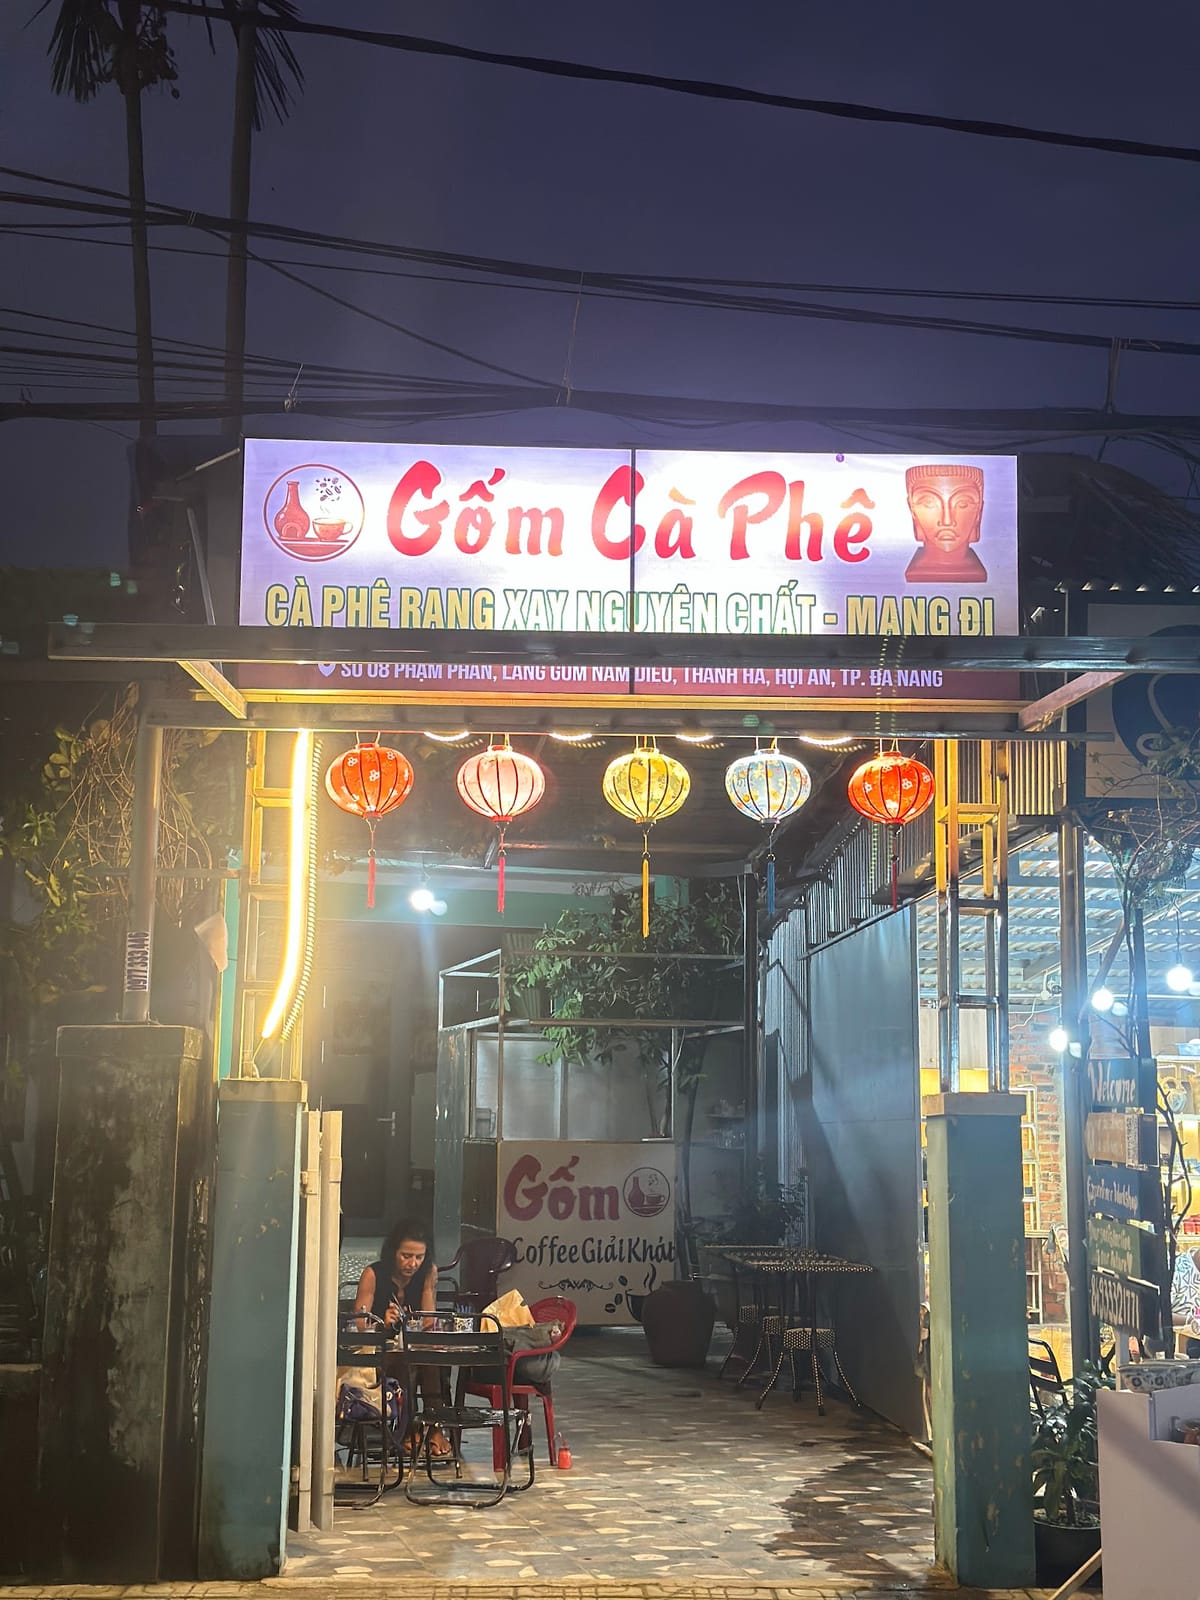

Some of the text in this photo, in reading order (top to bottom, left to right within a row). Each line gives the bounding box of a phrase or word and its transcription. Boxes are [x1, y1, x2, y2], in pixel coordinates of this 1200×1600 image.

[387, 460, 876, 562] Gốm Cà Phê
[265, 576, 314, 627] CÀ
[321, 578, 391, 629] PHÊ
[400, 587, 495, 630] RANG
[503, 588, 569, 631] XAY
[576, 583, 718, 633] NGUYÊN
[725, 580, 816, 634] CHẤT
[847, 595, 951, 636] MANG
[958, 597, 994, 636] ĐI
[503, 1154, 620, 1221] Gốm
